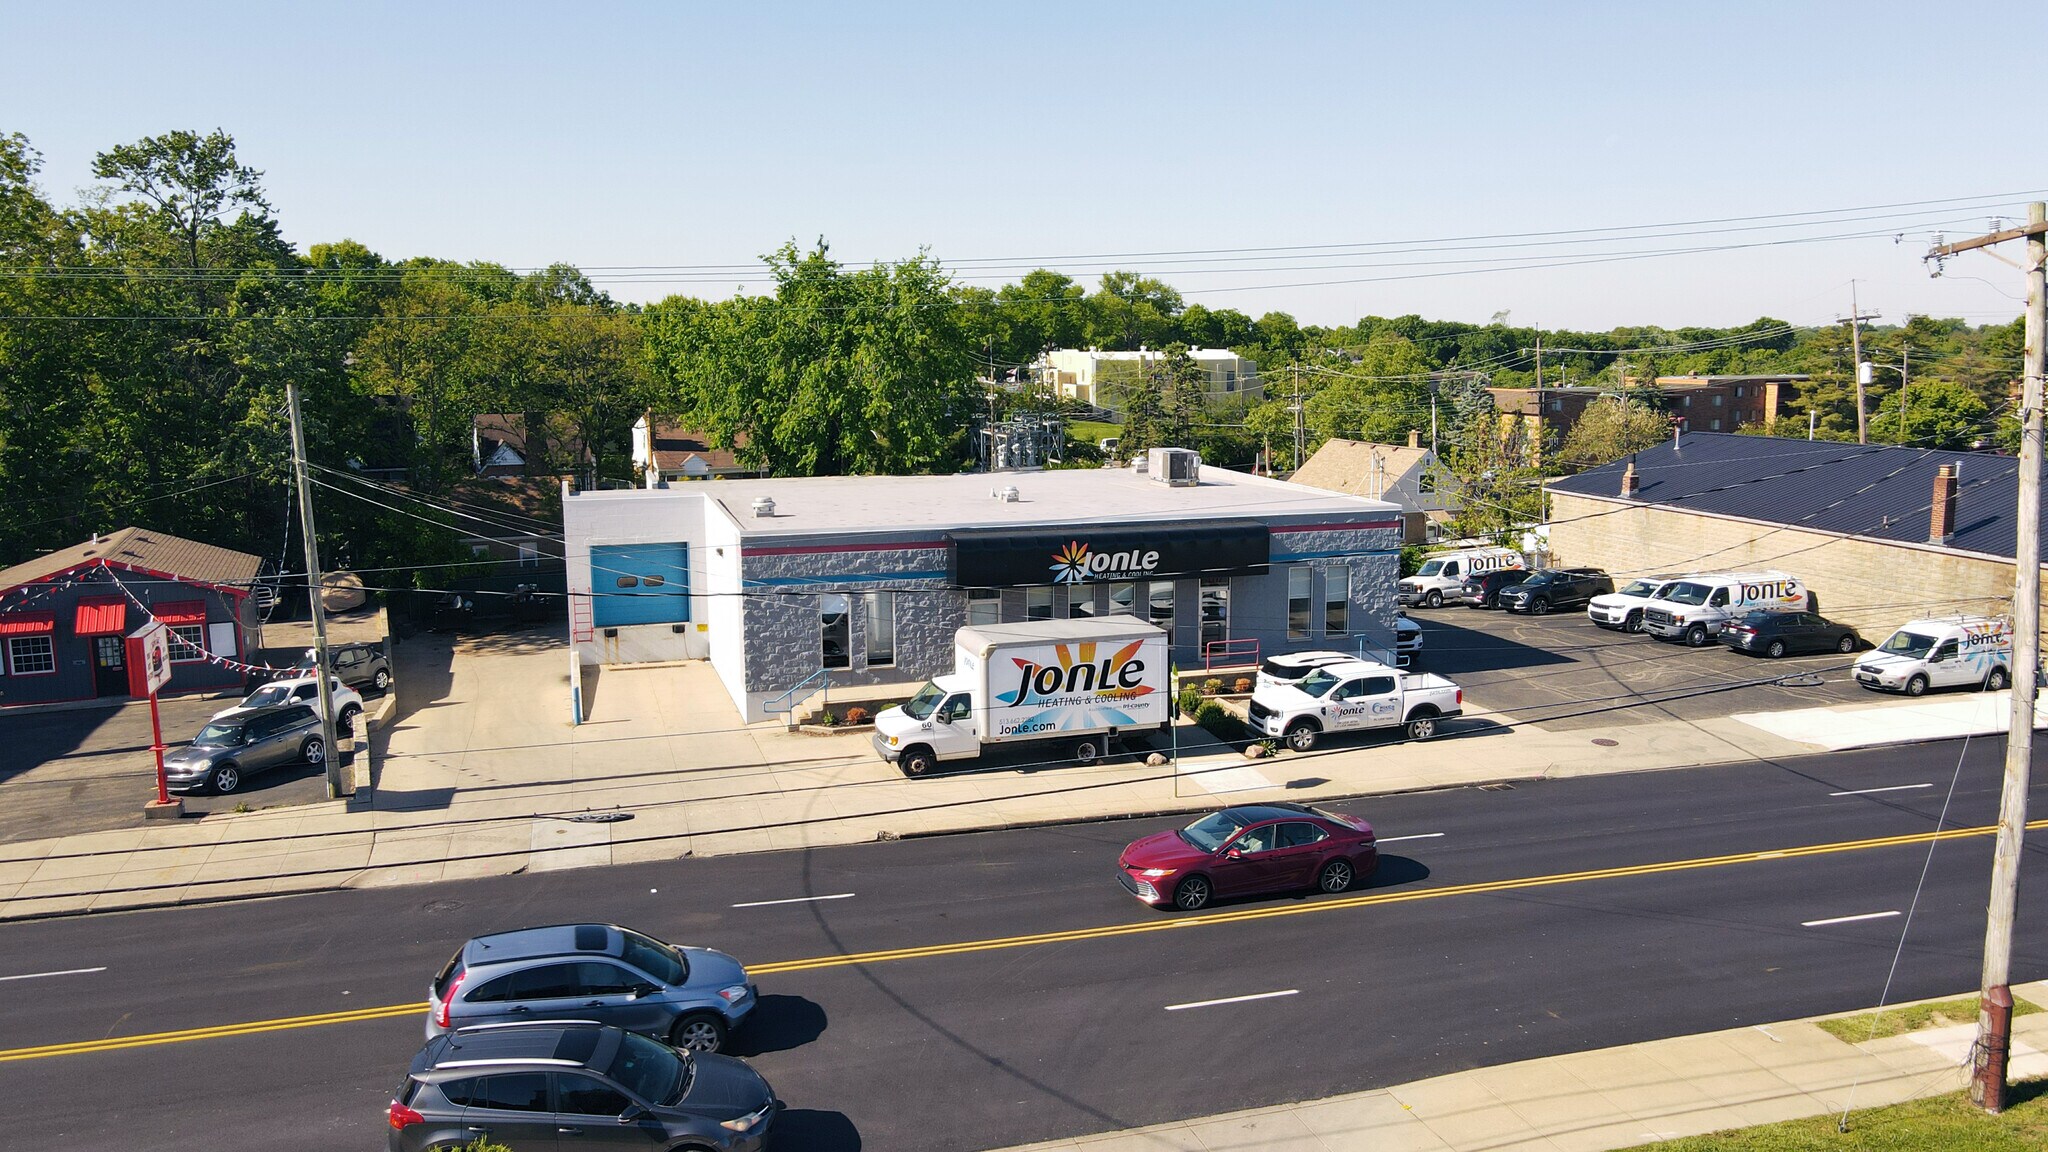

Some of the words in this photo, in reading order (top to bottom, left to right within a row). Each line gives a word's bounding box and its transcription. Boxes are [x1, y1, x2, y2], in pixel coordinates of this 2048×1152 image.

[1038, 696, 1082, 709] HEATING
[1085, 695, 1092, 705] &
[1095, 691, 1137, 704] COOLING
